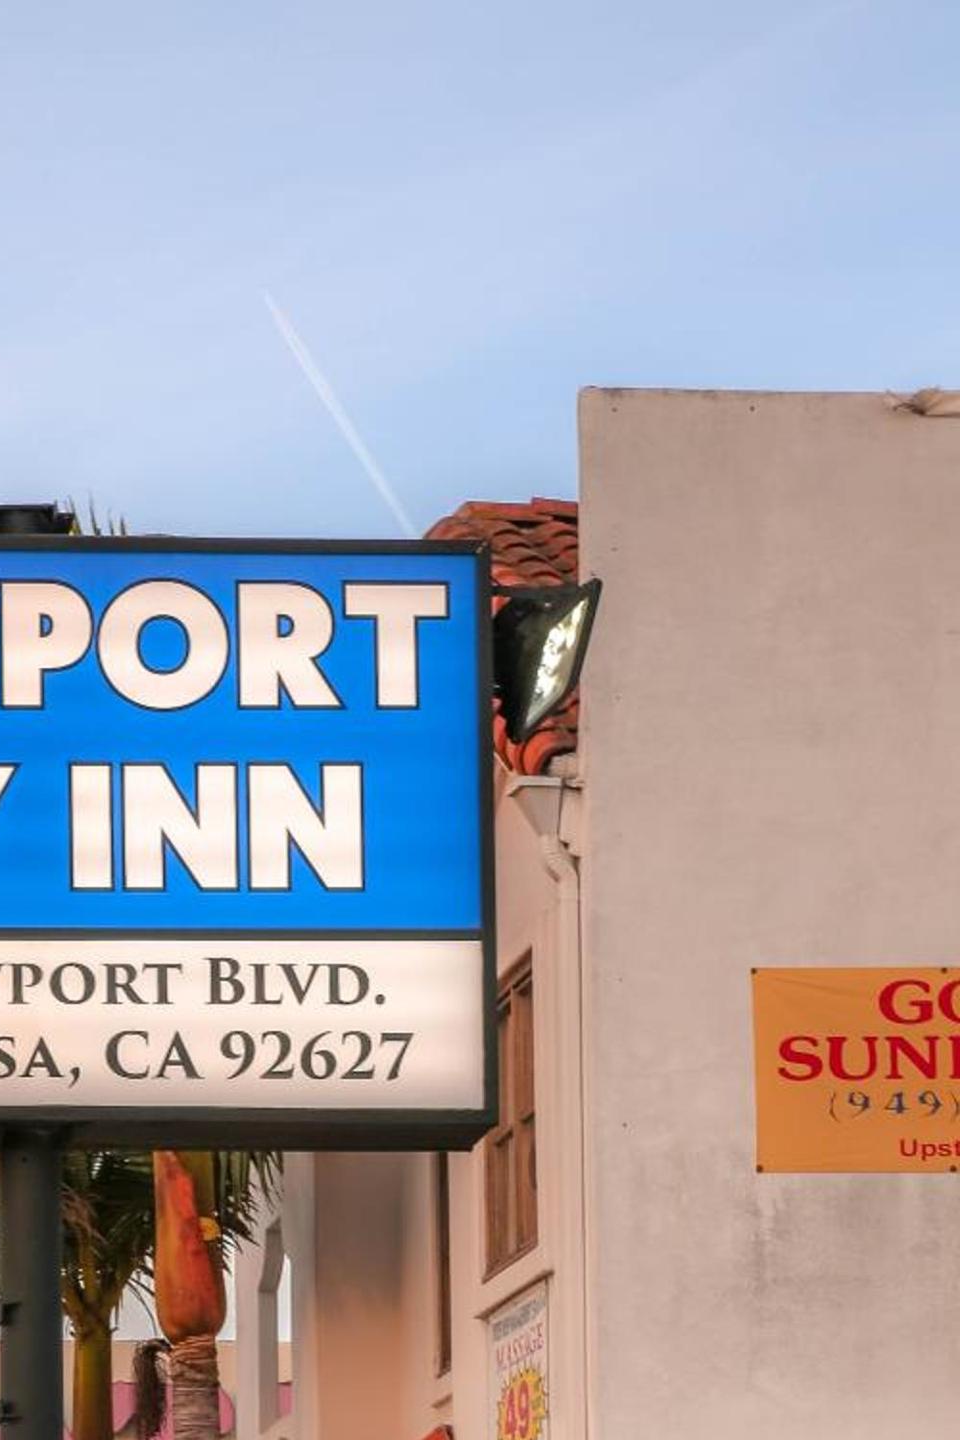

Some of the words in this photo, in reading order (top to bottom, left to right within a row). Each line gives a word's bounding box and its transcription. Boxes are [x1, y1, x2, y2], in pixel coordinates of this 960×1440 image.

[67, 761, 366, 892] INN
[106, 1030, 205, 1080] CA
[220, 1030, 415, 1081] 92627
